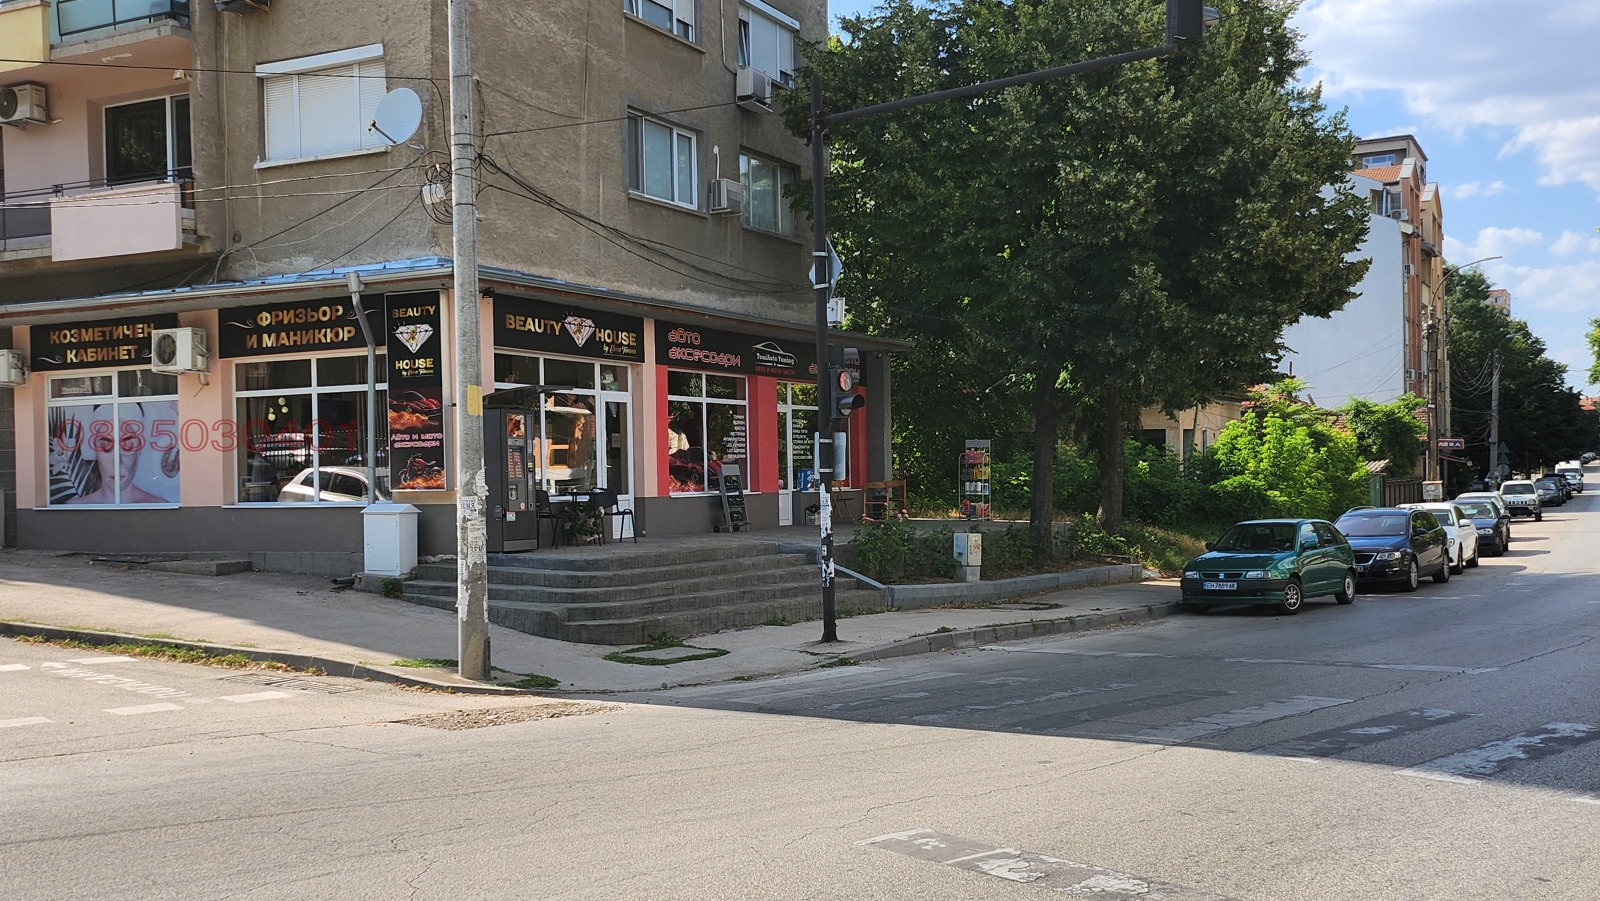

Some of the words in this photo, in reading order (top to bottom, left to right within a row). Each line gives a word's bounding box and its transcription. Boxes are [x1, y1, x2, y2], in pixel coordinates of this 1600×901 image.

[256, 304, 344, 328] ФРИЗЬОР
[392, 305, 436, 318] BEAUTY
[50, 323, 154, 345] КОЗМЕТИЧЕН
[505, 313, 562, 336] BEAUTY
[246, 335, 257, 349] И
[261, 326, 356, 348] МАНИКЮР
[595, 327, 637, 347] HOUSE
[66, 345, 138, 364] КАБИНЕТ
[395, 358, 434, 370] HOUSE
[778, 355, 795, 366] Tuning
